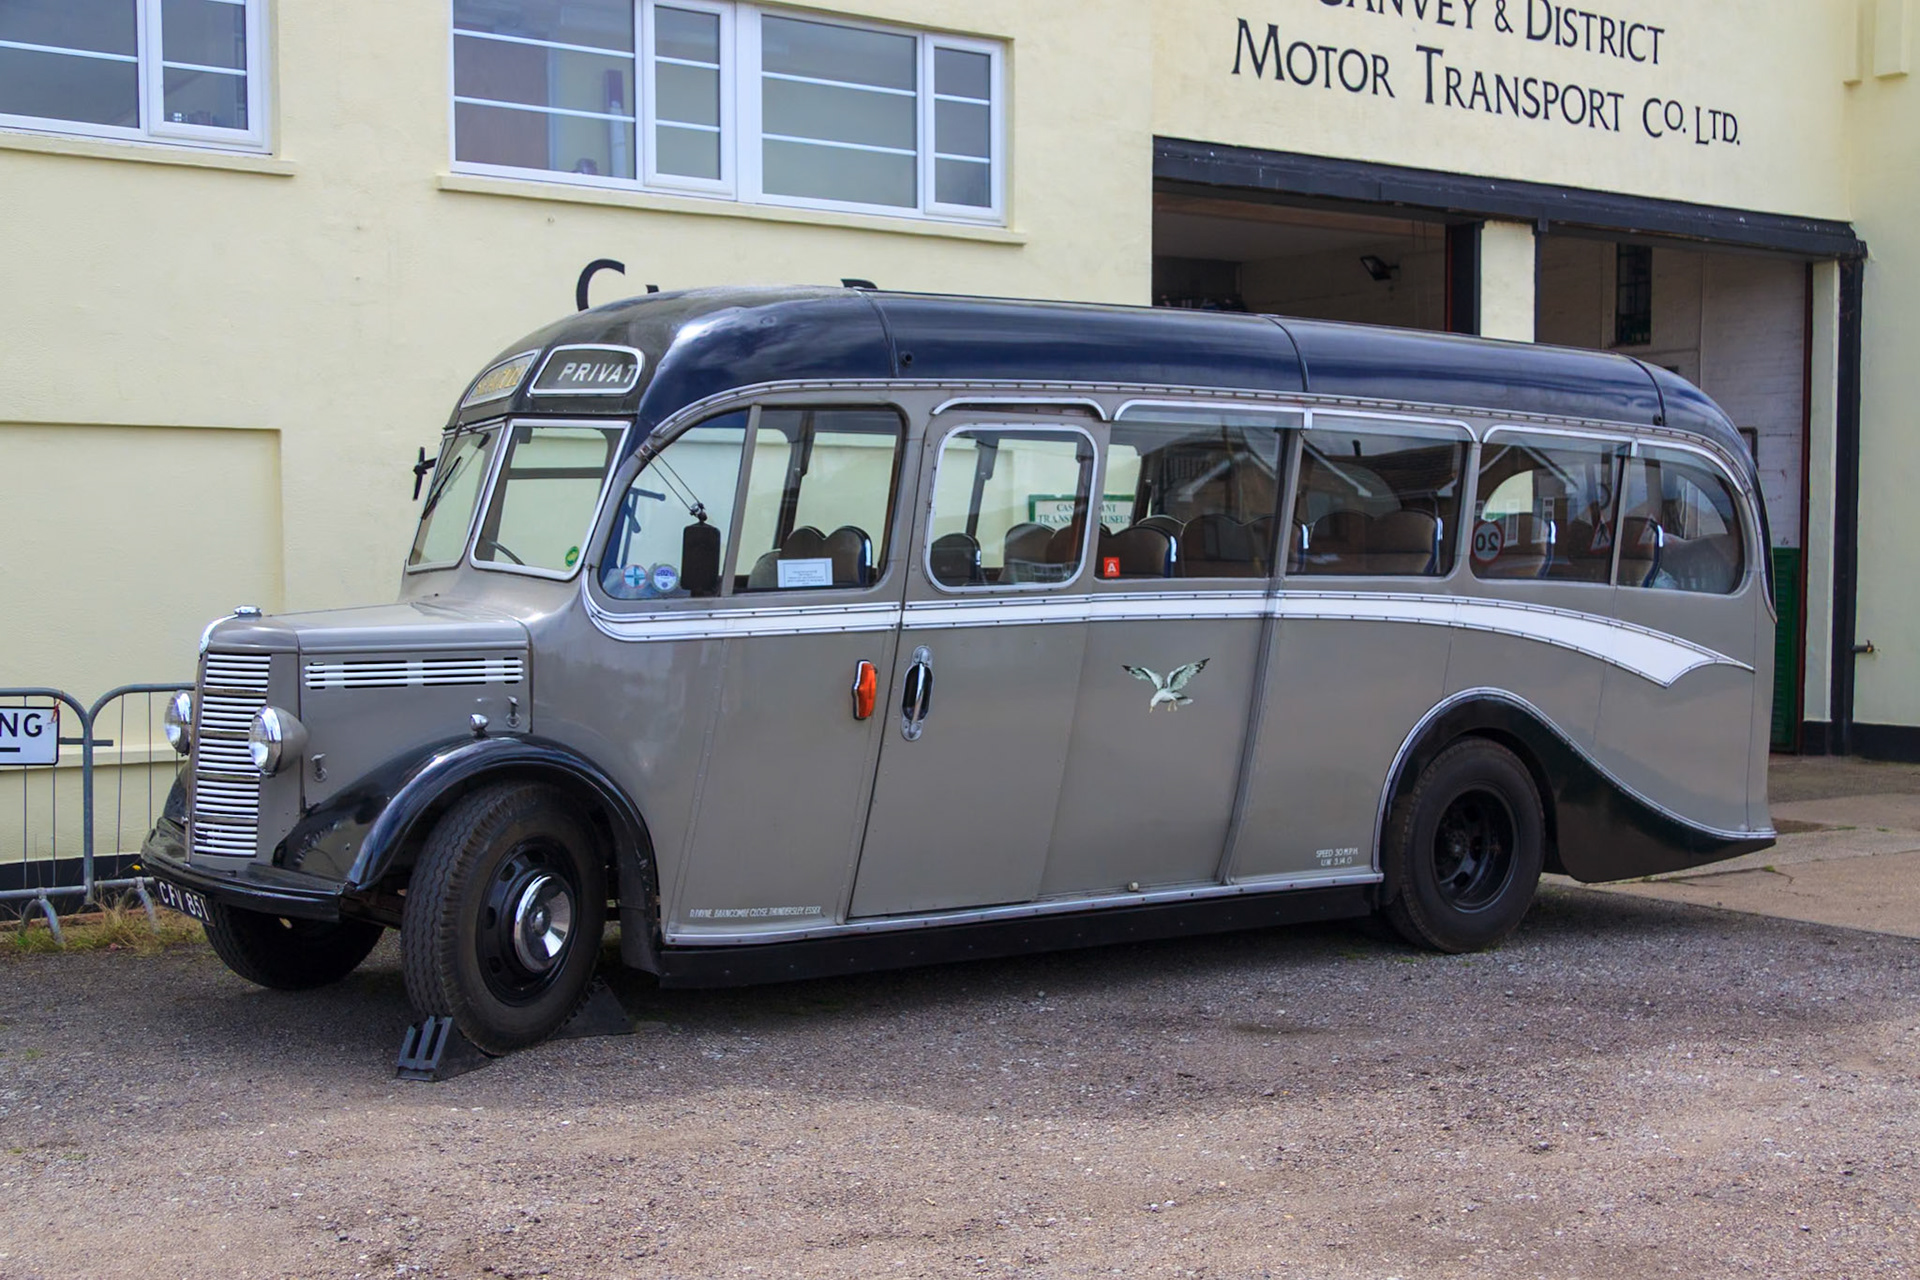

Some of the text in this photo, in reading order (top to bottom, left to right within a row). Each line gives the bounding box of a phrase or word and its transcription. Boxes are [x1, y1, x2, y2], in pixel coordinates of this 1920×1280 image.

[1494, 0, 1514, 33] &
[1526, 0, 1665, 65] DISTRICT
[1231, 17, 1741, 146] MOTOR TRANSPORT CO. LTD.
[1107, 562, 1117, 573] A
[159, 881, 209, 921] CFV 851
